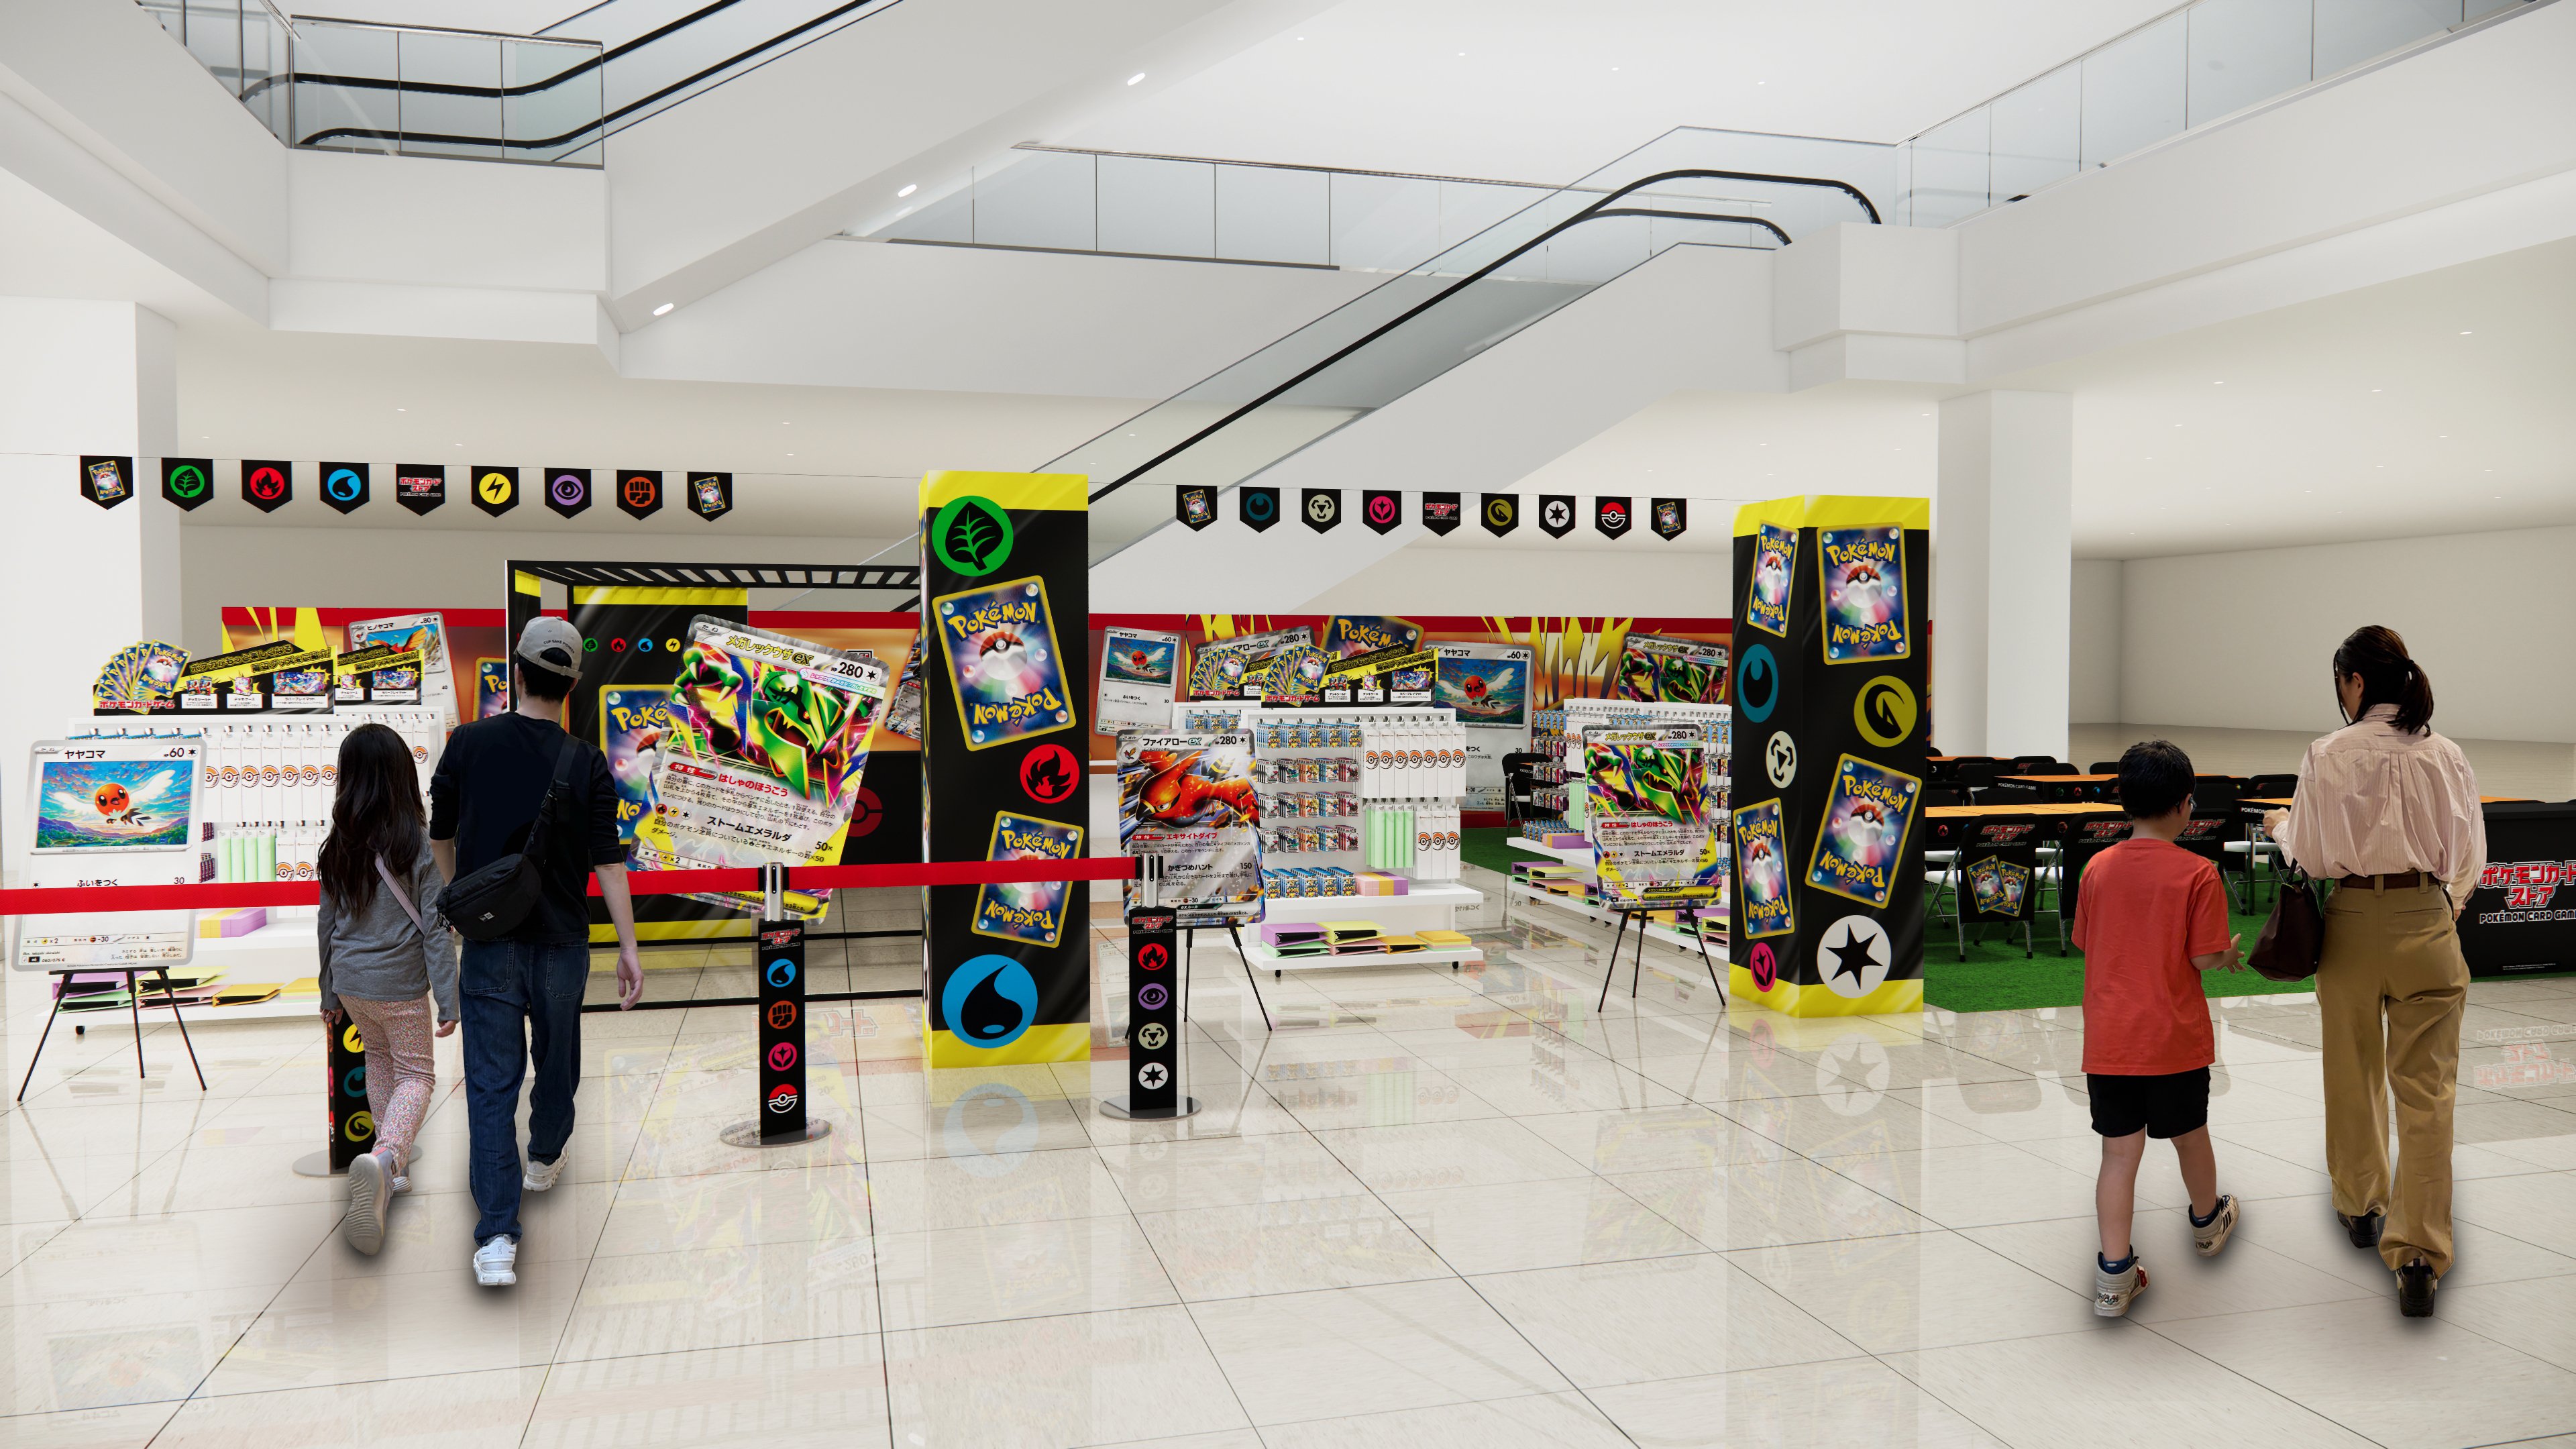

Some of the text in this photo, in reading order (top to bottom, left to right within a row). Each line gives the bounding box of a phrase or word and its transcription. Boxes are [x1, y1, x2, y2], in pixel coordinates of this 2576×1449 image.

[367, 623, 394, 631] ヒノヤコマ
[1284, 634, 1299, 643] 280
[1338, 619, 1409, 649] Pokém
[1444, 649, 1470, 657] ヤヤコマ
[1702, 648, 1715, 656] 280
[838, 661, 863, 678] 280
[1265, 694, 1320, 702] ポケモンカードゲーム
[99, 700, 175, 709] ポケモンカードゲーム
[610, 699, 667, 733] Poké
[1219, 736, 1236, 745] 280
[64, 749, 105, 759] ヤヤコマ
[169, 747, 184, 757] 60
[718, 773, 788, 798] はしゃのほうこう
[706, 816, 793, 842] ストームエメラルダ
[77, 877, 184, 888] ふいをつく 30
[2505, 885, 2556, 909] ストア
[2479, 910, 2526, 924] POKÉMON
[2526, 910, 2553, 922] CARD
